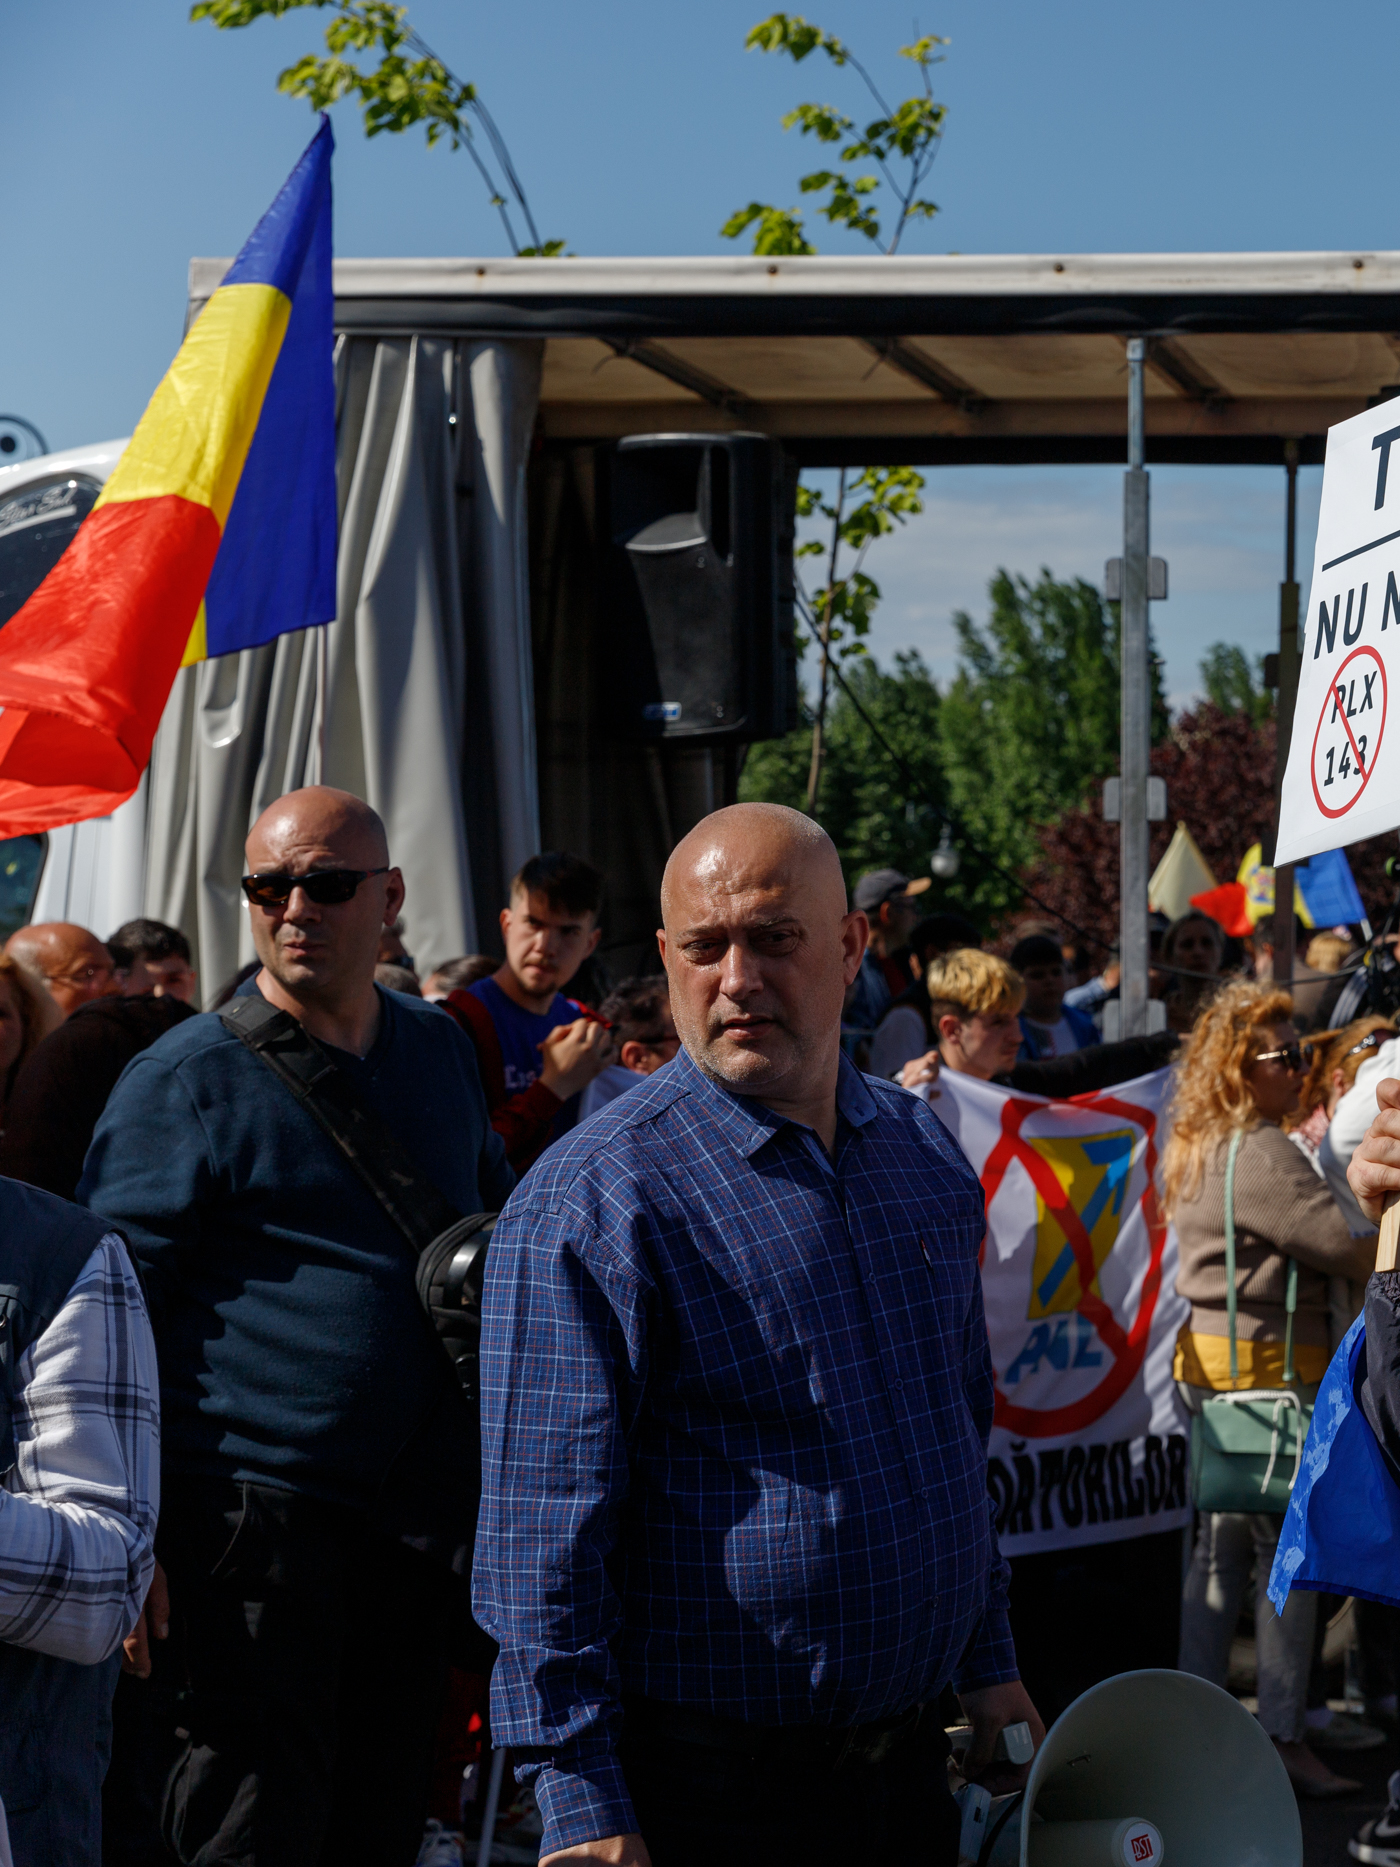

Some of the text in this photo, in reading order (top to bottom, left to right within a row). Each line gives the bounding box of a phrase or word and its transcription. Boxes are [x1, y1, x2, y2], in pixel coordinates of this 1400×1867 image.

[1313, 582, 1369, 660] NU
[1331, 671, 1377, 724] PLX
[1323, 735, 1368, 787] 143
